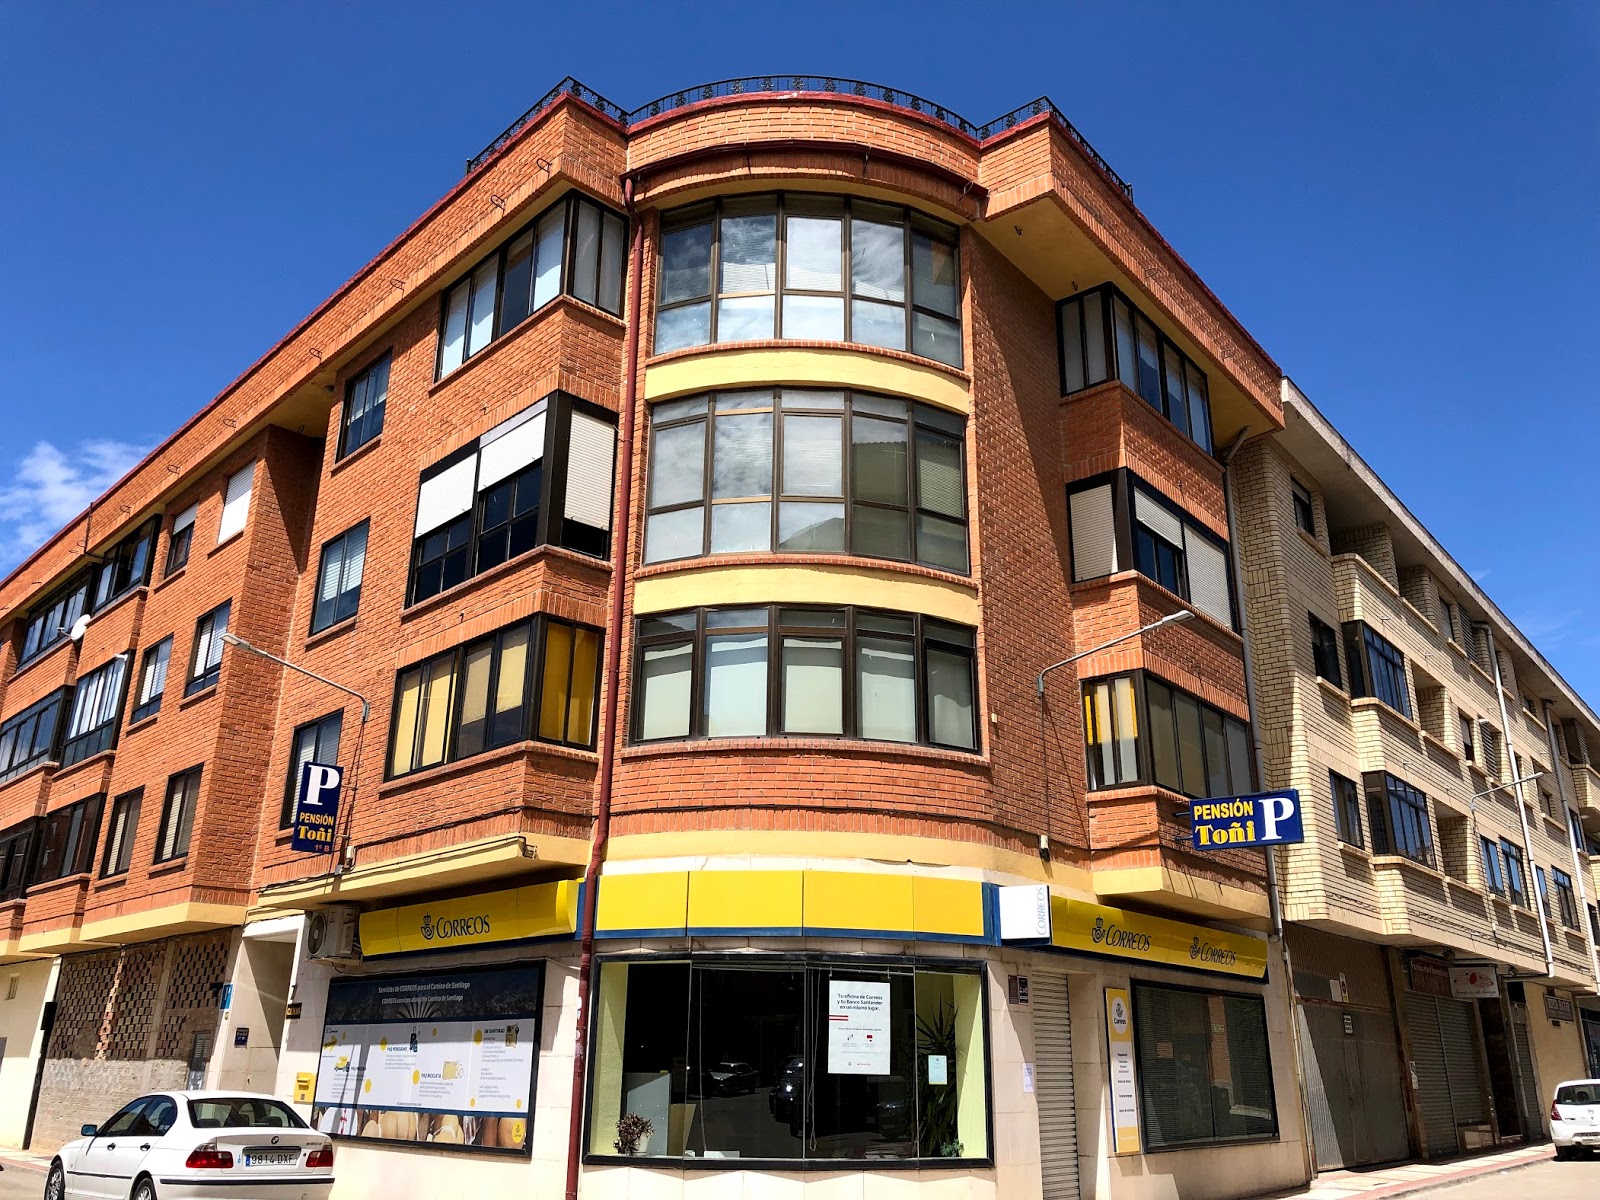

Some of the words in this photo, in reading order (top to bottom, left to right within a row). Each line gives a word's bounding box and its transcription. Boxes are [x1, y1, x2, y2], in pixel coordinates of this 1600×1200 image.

[302, 764, 340, 806] P
[299, 812, 335, 826] PENSIÓN
[1193, 798, 1254, 821] PENSIÓN
[1258, 797, 1295, 841] P
[297, 825, 333, 842] Toñi
[1194, 820, 1257, 846] Toñi
[1036, 886, 1047, 936] CORREOS
[436, 914, 491, 939] CORREOS
[1105, 924, 1152, 952] CORREOS
[1200, 942, 1238, 966] CORREOS
[251, 1154, 274, 1165] 9814
